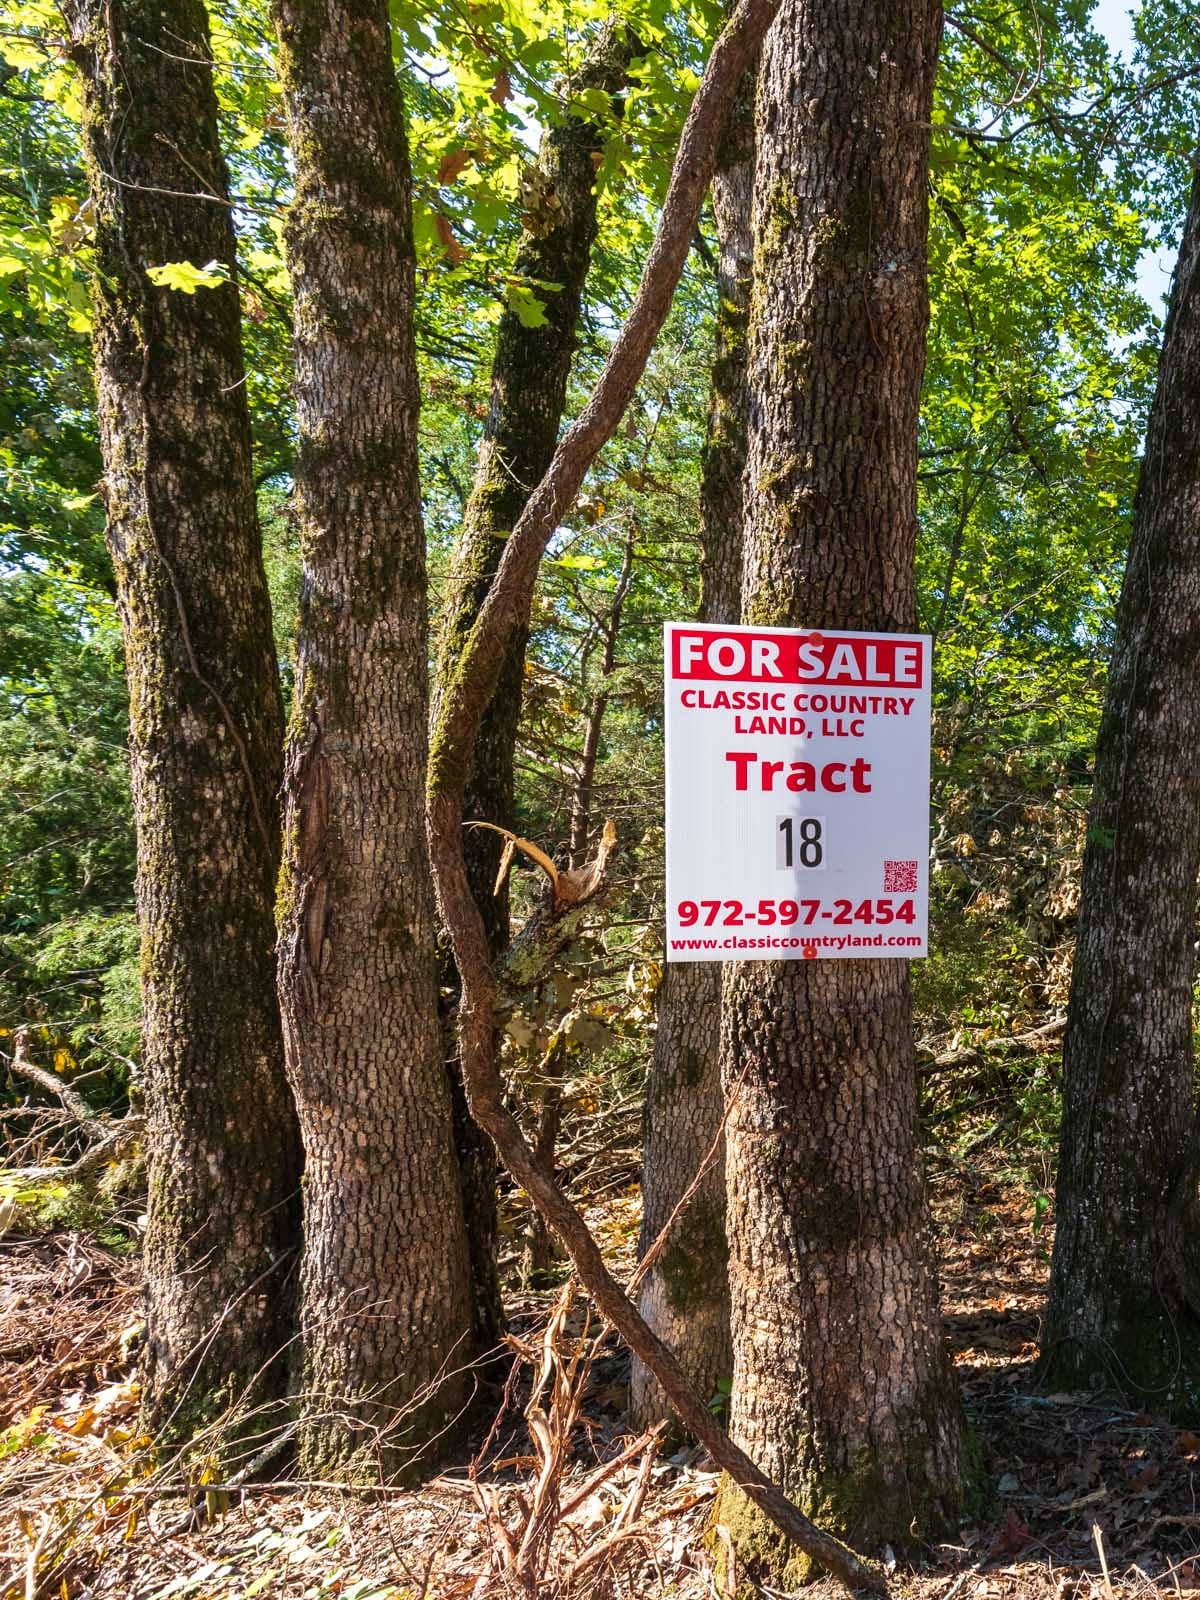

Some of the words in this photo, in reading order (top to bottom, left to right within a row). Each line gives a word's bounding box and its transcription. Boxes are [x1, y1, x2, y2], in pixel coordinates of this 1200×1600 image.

[679, 636, 783, 678] FOR
[798, 641, 918, 683] SALE
[680, 689, 786, 711] CLASSIC
[794, 694, 915, 715] COUNTRY
[735, 716, 813, 739] LAND,
[822, 718, 865, 737] LLC
[725, 752, 872, 793] Tract
[779, 818, 823, 868] 18
[677, 899, 916, 927] 972-597-2454
[671, 934, 922, 950] www.classiccountryland.com
